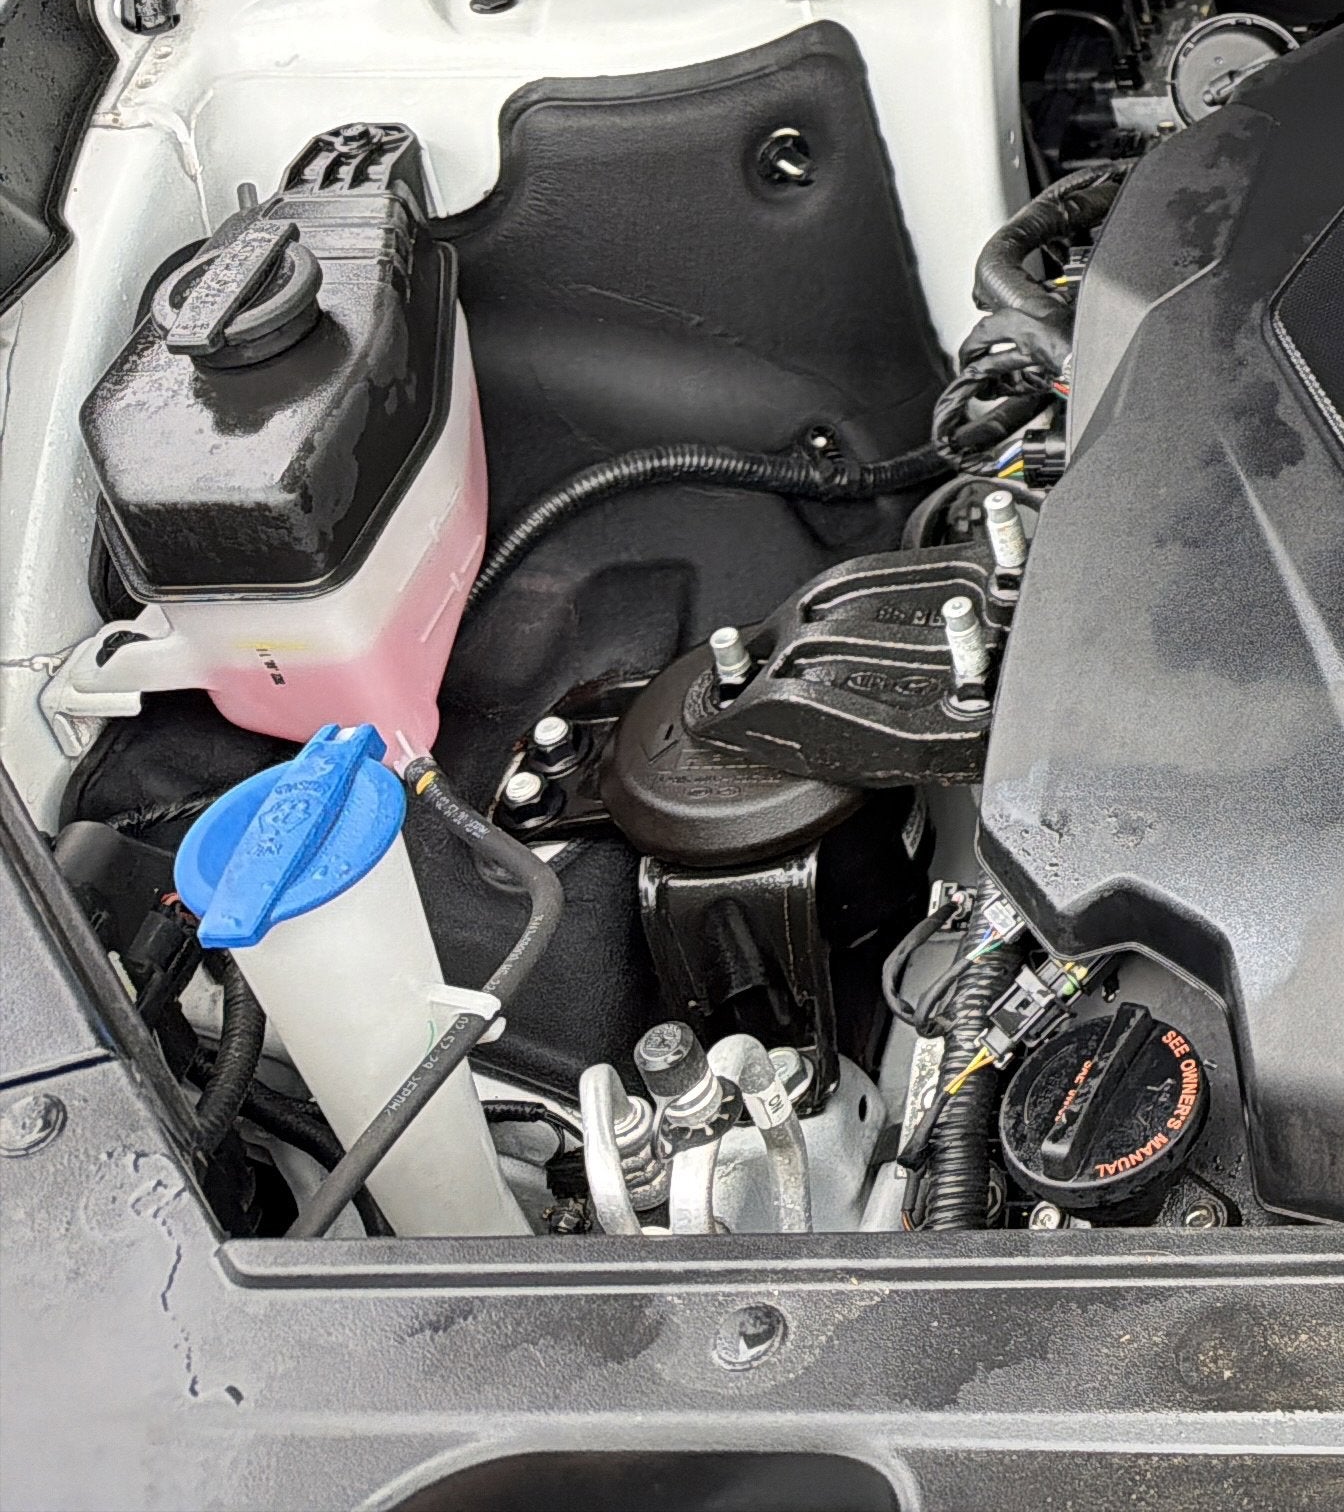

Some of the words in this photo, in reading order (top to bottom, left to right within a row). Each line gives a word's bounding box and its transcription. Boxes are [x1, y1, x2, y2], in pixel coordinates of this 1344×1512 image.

[1162, 1031, 1190, 1057] SEE
[1167, 1059, 1199, 1130] OWNER'S
[1095, 1132, 1168, 1177] MANUAL
